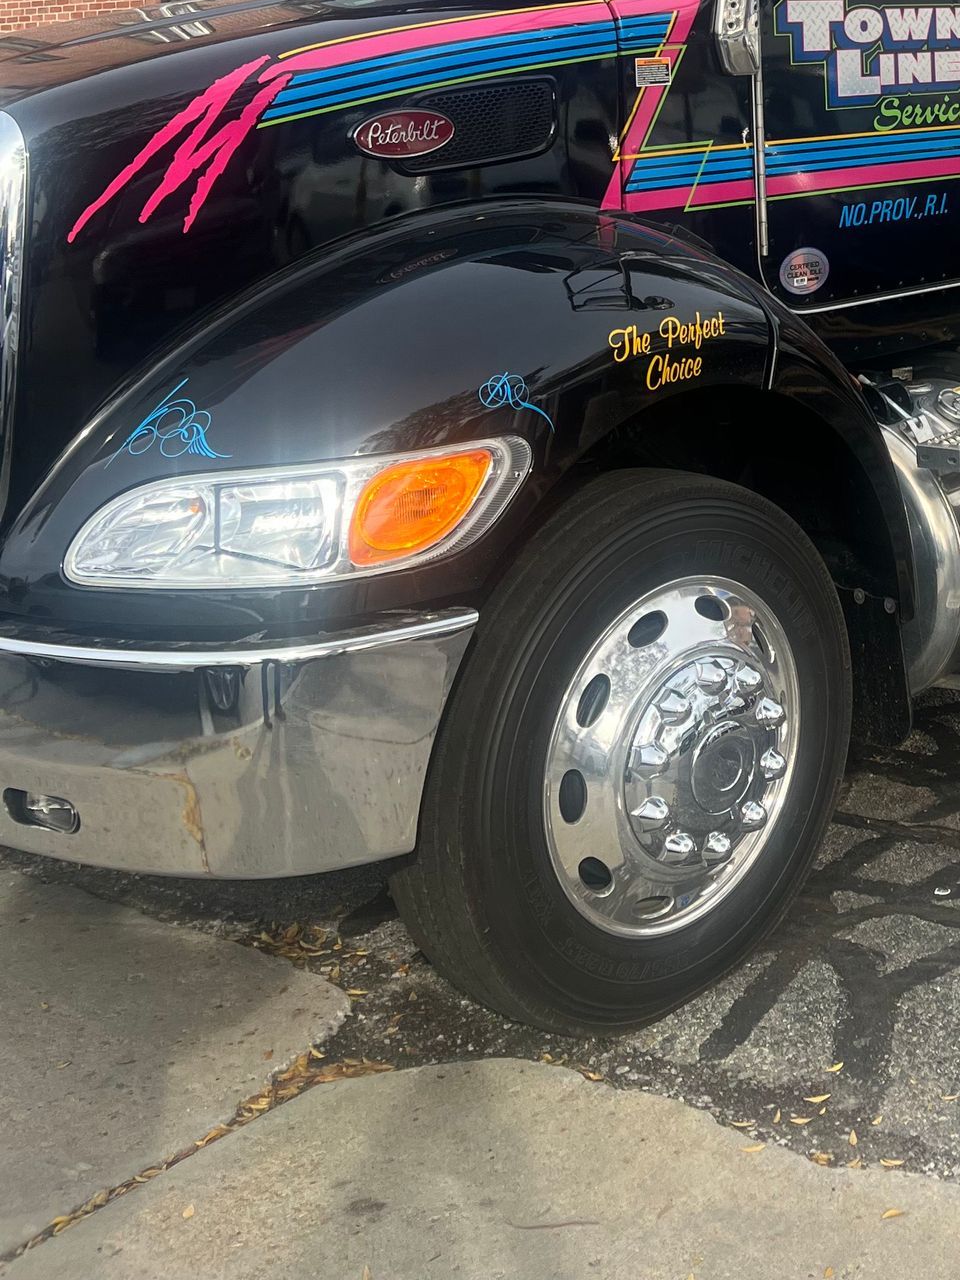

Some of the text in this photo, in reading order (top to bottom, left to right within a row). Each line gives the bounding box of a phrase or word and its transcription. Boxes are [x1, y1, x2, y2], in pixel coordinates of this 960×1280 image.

[366, 119, 446, 149] Peterbilt
[786, 271, 808, 279] CLEAN
[789, 261, 820, 271] CERTIFIED
[608, 311, 726, 362] The Perfect
[646, 353, 702, 391] Choice
